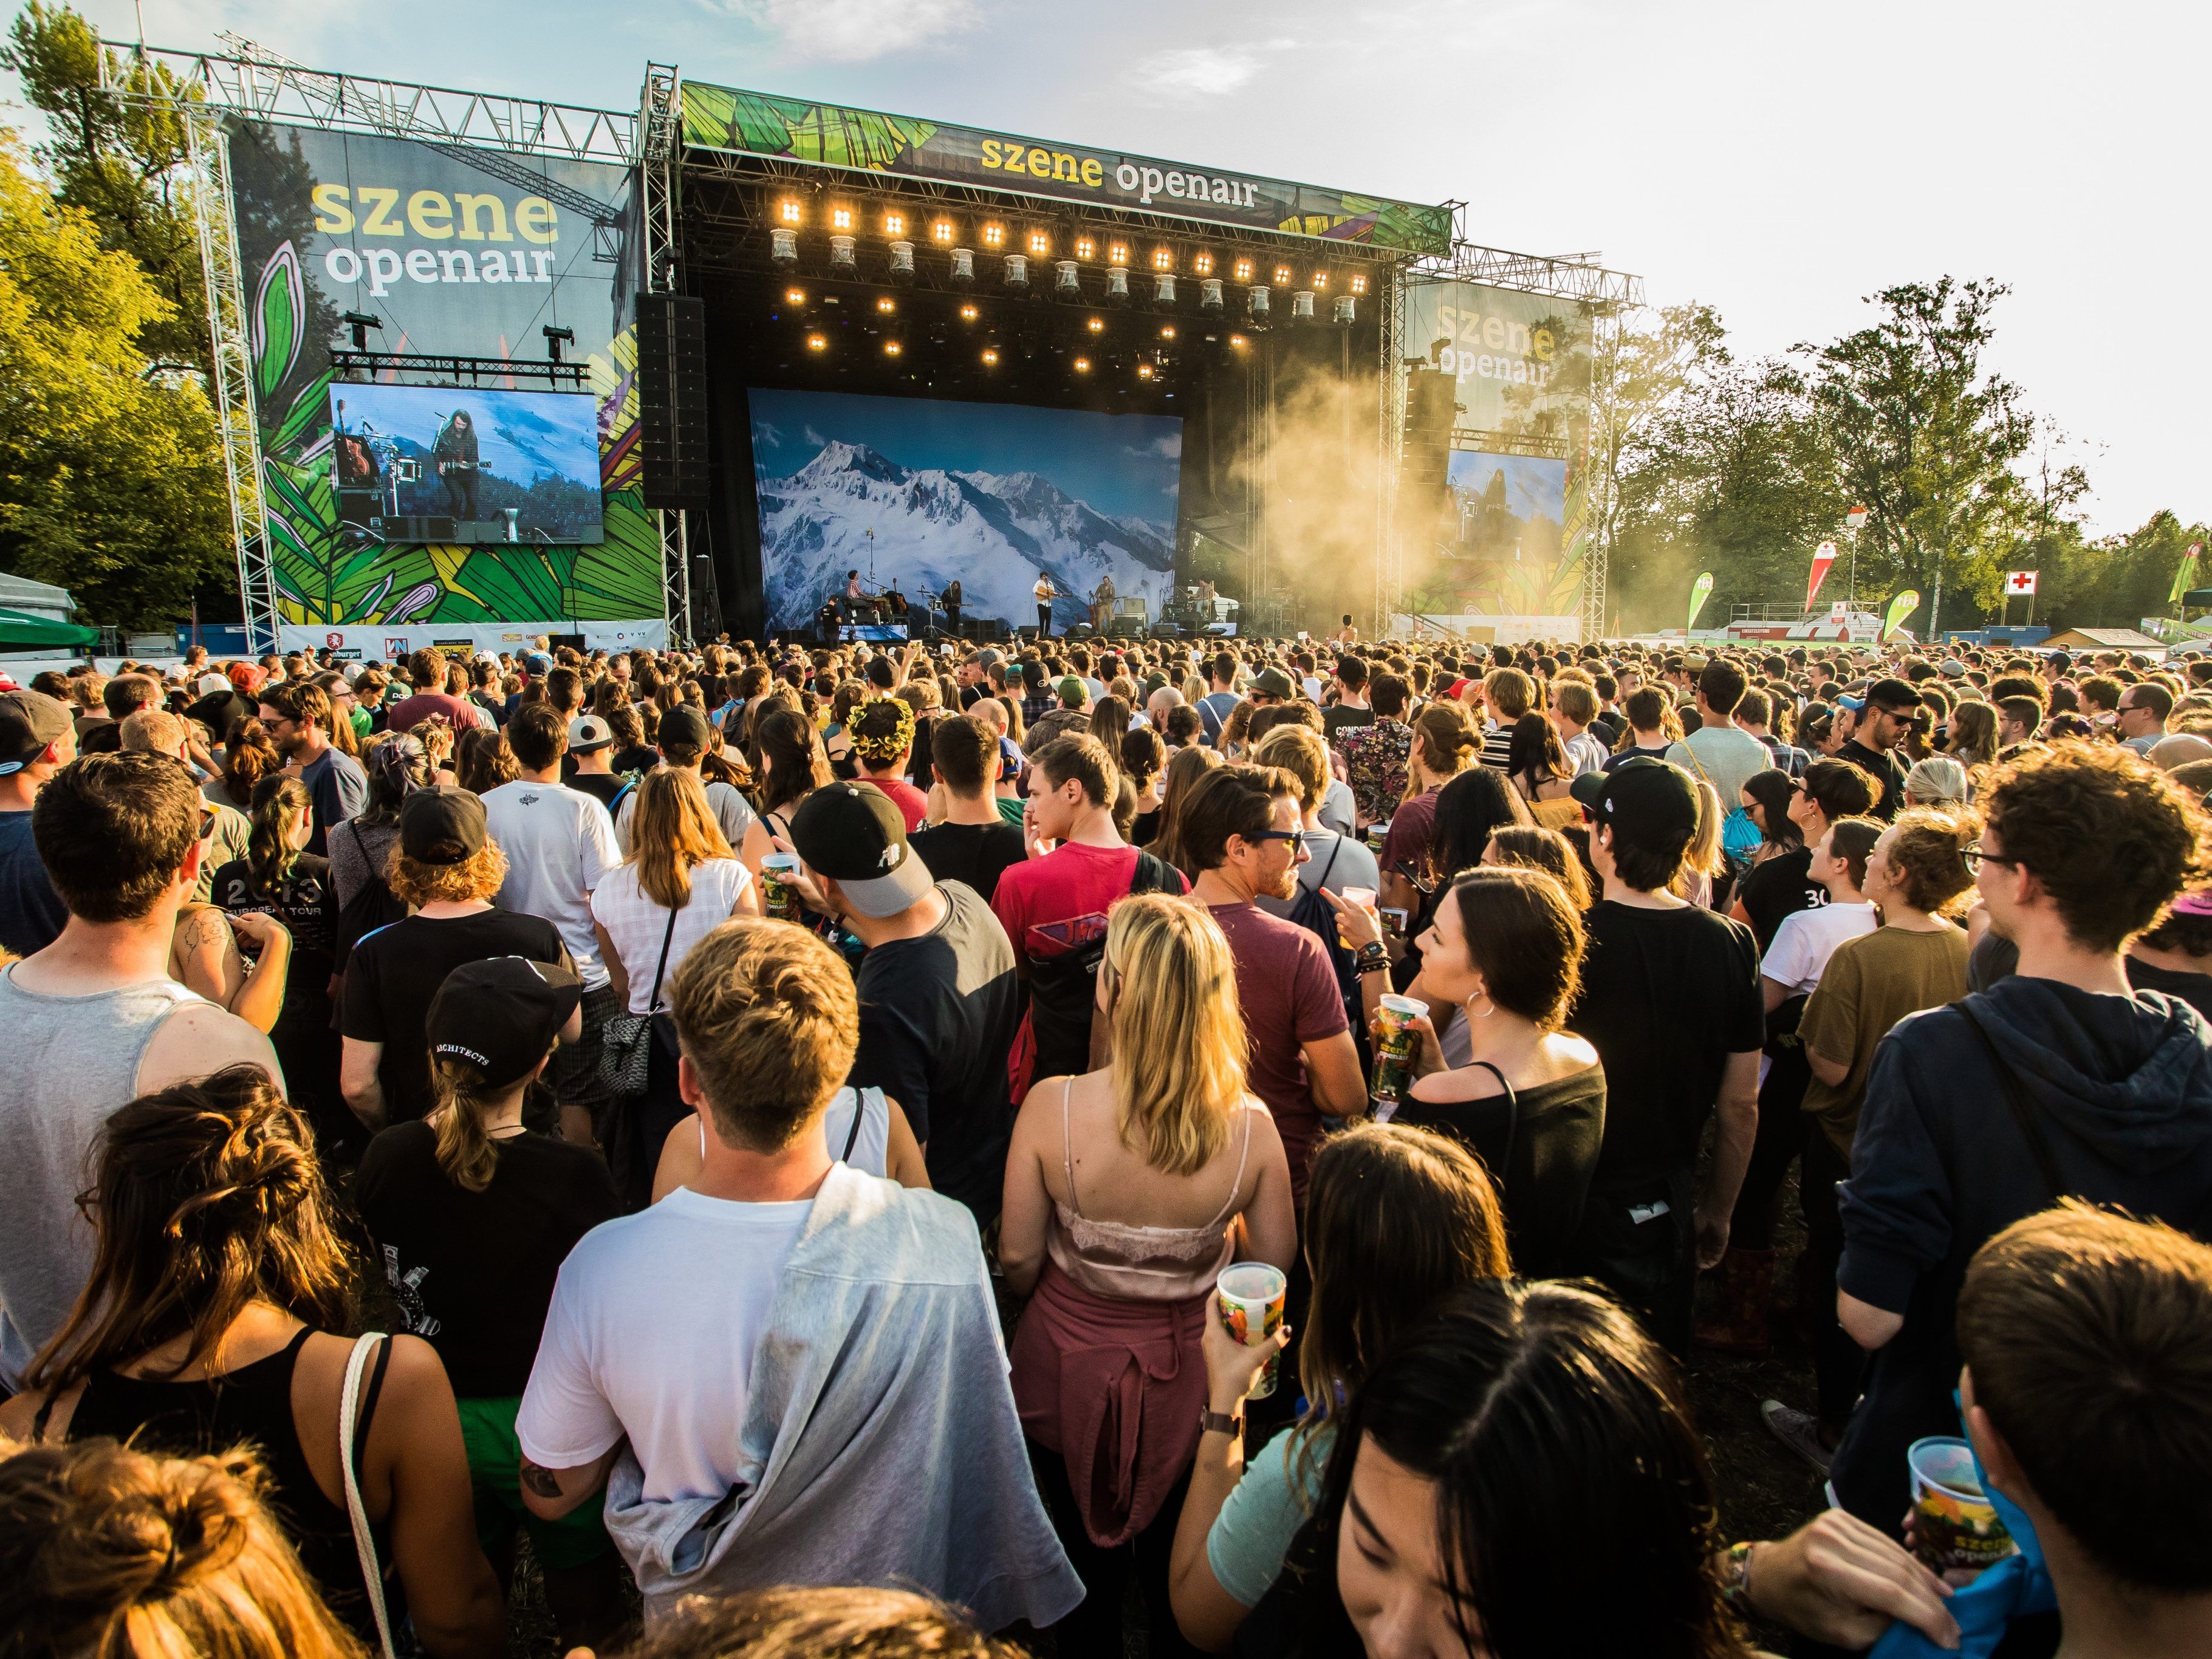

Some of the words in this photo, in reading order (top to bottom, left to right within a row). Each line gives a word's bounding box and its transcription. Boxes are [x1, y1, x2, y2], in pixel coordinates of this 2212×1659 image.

[981, 140, 1103, 187] szene
[1116, 163, 1259, 208] openair
[311, 183, 560, 244] szene
[325, 244, 556, 298] openair
[1437, 306, 1555, 361] szene
[1440, 347, 1549, 387] openair
[386, 639, 407, 653] VN
[289, 907, 322, 915] TOUR
[436, 1044, 489, 1066] ARCHITECTS
[1954, 1535, 2013, 1552] szen
